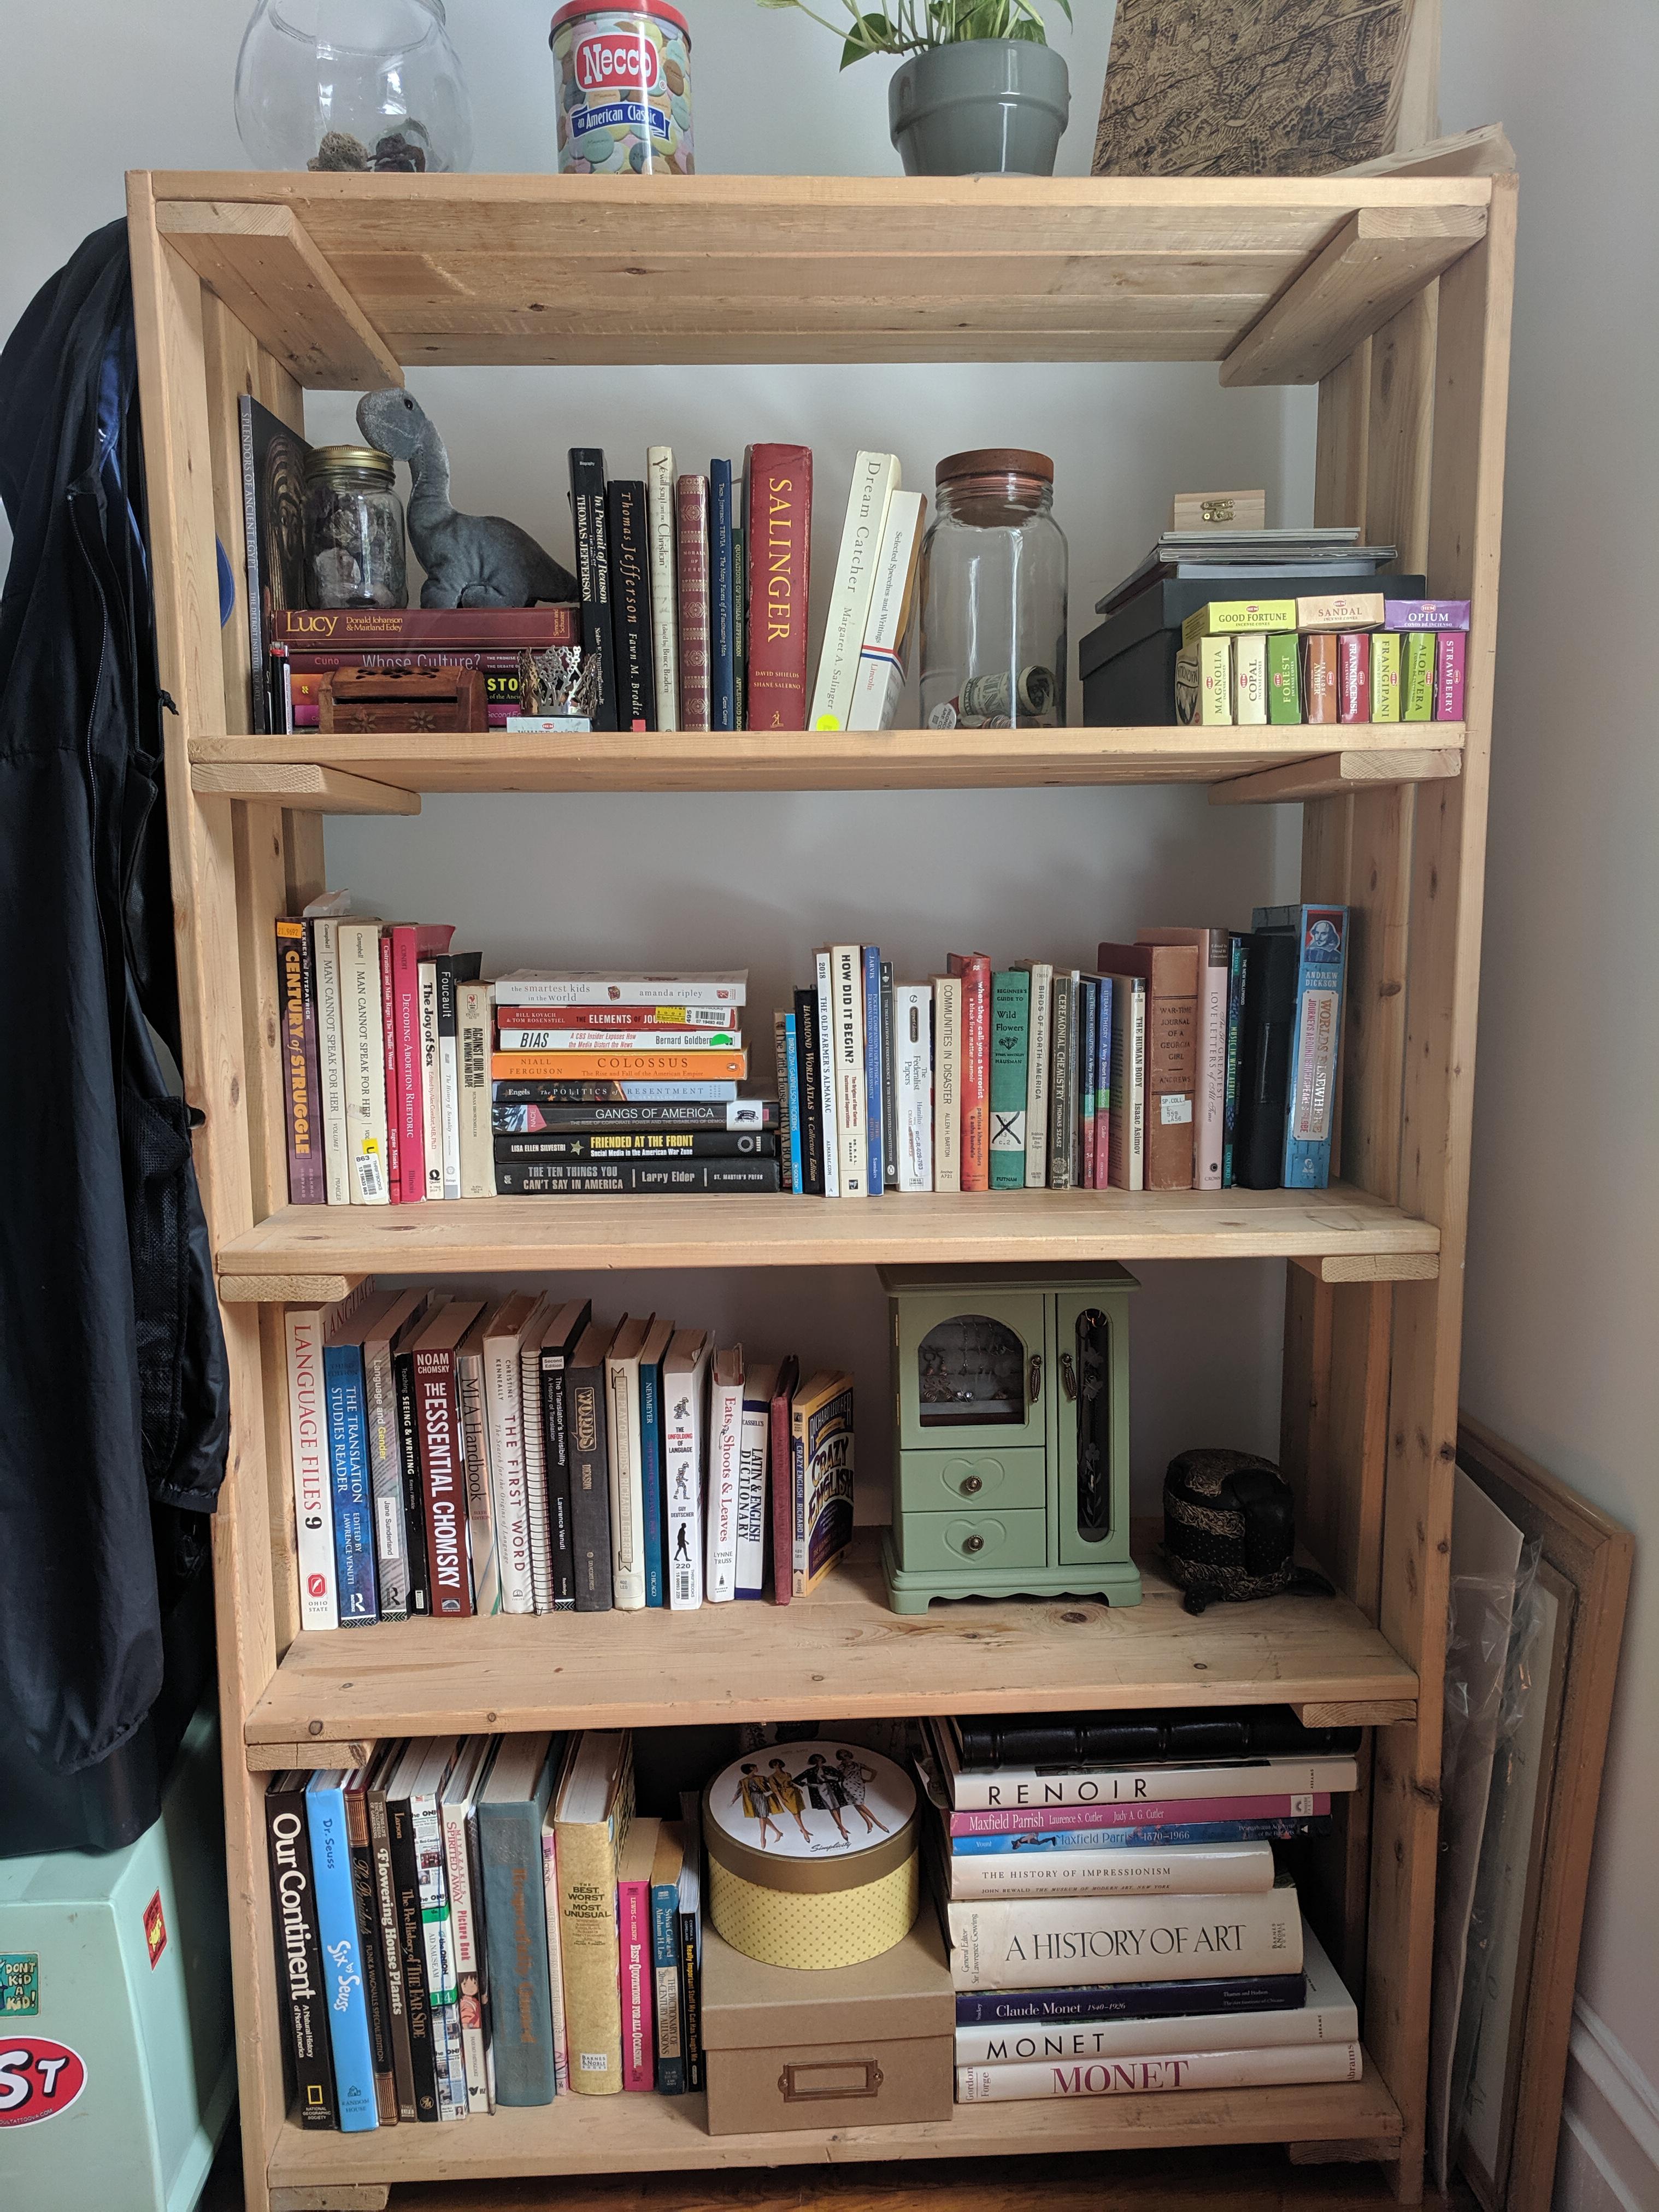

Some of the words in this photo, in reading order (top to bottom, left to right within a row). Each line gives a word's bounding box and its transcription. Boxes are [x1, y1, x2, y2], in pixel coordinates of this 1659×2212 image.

[583, 44, 651, 84] Necco
[578, 118, 584, 128] an
[586, 109, 622, 129] American
[628, 105, 656, 125] Clasic
[860, 462, 881, 517] Dream
[621, 492, 633, 540] Thomas
[768, 478, 792, 643] SALINGER
[847, 526, 870, 593] Catcher
[620, 543, 640, 622] Jefferson
[286, 611, 338, 636] Lucy
[1219, 613, 1245, 622] GOOD
[1247, 613, 1287, 621] FORTUNE
[1318, 608, 1362, 617] SANDAL
[1408, 613, 1449, 621] OPIUM
[838, 607, 852, 652] Margaret
[630, 633, 638, 660] Fawn
[1419, 644, 1427, 675] ALOE
[631, 665, 638, 678] M.
[867, 663, 878, 691] Lincoln
[1349, 643, 1357, 714] FRANKINCENSE
[1381, 640, 1390, 717] FRANGIPANI
[1445, 640, 1454, 713] STRAWBERRY
[828, 670, 841, 709] Salinger
[842, 955, 851, 981] HOW
[286, 950, 303, 1038] CENTURY
[442, 972, 451, 1017] Foucault
[525, 985, 566, 993] smartest
[569, 984, 590, 993] kids
[549, 992, 576, 1002] world
[678, 989, 702, 998] ripley
[843, 985, 851, 1005] DID
[843, 1008, 852, 1020] IT
[1038, 1016, 1043, 1027] OF
[289, 1040, 301, 1052] of
[520, 1033, 549, 1048] BIAS
[844, 1024, 854, 1064] BEGIN?
[597, 1058, 689, 1068] COLOSSUS
[291, 1055, 309, 1155] STRUGGLE
[596, 1109, 638, 1119] GANGS
[642, 1109, 657, 1118] OF
[660, 1108, 714, 1118] AMERICA
[591, 1137, 632, 1148] FRIENDED
[635, 1136, 646, 1146] AT
[649, 1136, 664, 1146] THE
[667, 1135, 693, 1146] FRONT
[523, 1180, 548, 1190] CAN'T
[551, 1180, 568, 1189] SAY
[572, 1180, 581, 1189] IN
[583, 1179, 623, 1189] AMERICA
[528, 1167, 544, 1177] THE
[546, 1167, 563, 1176] TEN
[566, 1167, 597, 1177] THINGS
[601, 1167, 617, 1176] YOU
[642, 1172, 669, 1183] Larry
[672, 1172, 695, 1182] Elder
[417, 1352, 449, 1366] NOAM
[417, 1366, 449, 1374] CHOMSKY
[294, 1325, 319, 1449] LANGUAGE
[424, 1383, 446, 1396] THE
[496, 1359, 504, 1401] KENNEALLY
[463, 1378, 480, 1415] MLA
[504, 1416, 517, 1448] THE
[578, 1390, 594, 1449] WORDS
[425, 1399, 453, 1498] ESSENTIAL
[466, 1422, 487, 1502] Handbook
[722, 1435, 735, 1479] Shoots
[301, 1455, 321, 1511] FILES
[508, 1460, 521, 1507] FIRST
[721, 1482, 733, 1496] &
[304, 1517, 322, 1529] 9
[720, 1498, 732, 1542] Leaves
[385, 1519, 393, 1555] Sunderland
[432, 1504, 461, 1589] CHOMSKY
[511, 1520, 525, 1572] WORD
[989, 1779, 1147, 1805] RENOIR
[969, 1815, 1009, 1831] Maxfield
[1012, 1812, 1044, 1828] Parrish
[273, 1813, 302, 1868] Our
[810, 1842, 852, 1852] Simplicity
[1083, 1867, 1171, 1876] IMPRESSIONISM
[279, 1870, 316, 2001] Continent
[1005, 1935, 1026, 1961] A
[1034, 1928, 1146, 1960] HISTORY
[1150, 1927, 1188, 1954] OF
[1193, 1925, 1246, 1952] ART
[327, 1940, 350, 1966] Six
[346, 1961, 355, 1972] by
[6, 1962, 35, 1974] DON'T
[16, 1986, 23, 1996] A
[333, 1975, 360, 2013] Seuss
[996, 2004, 1040, 2017] Claude
[1042, 2004, 1081, 2015] Monet
[987, 2033, 1105, 2060] MONET
[1050, 2061, 1189, 2094] MONET
